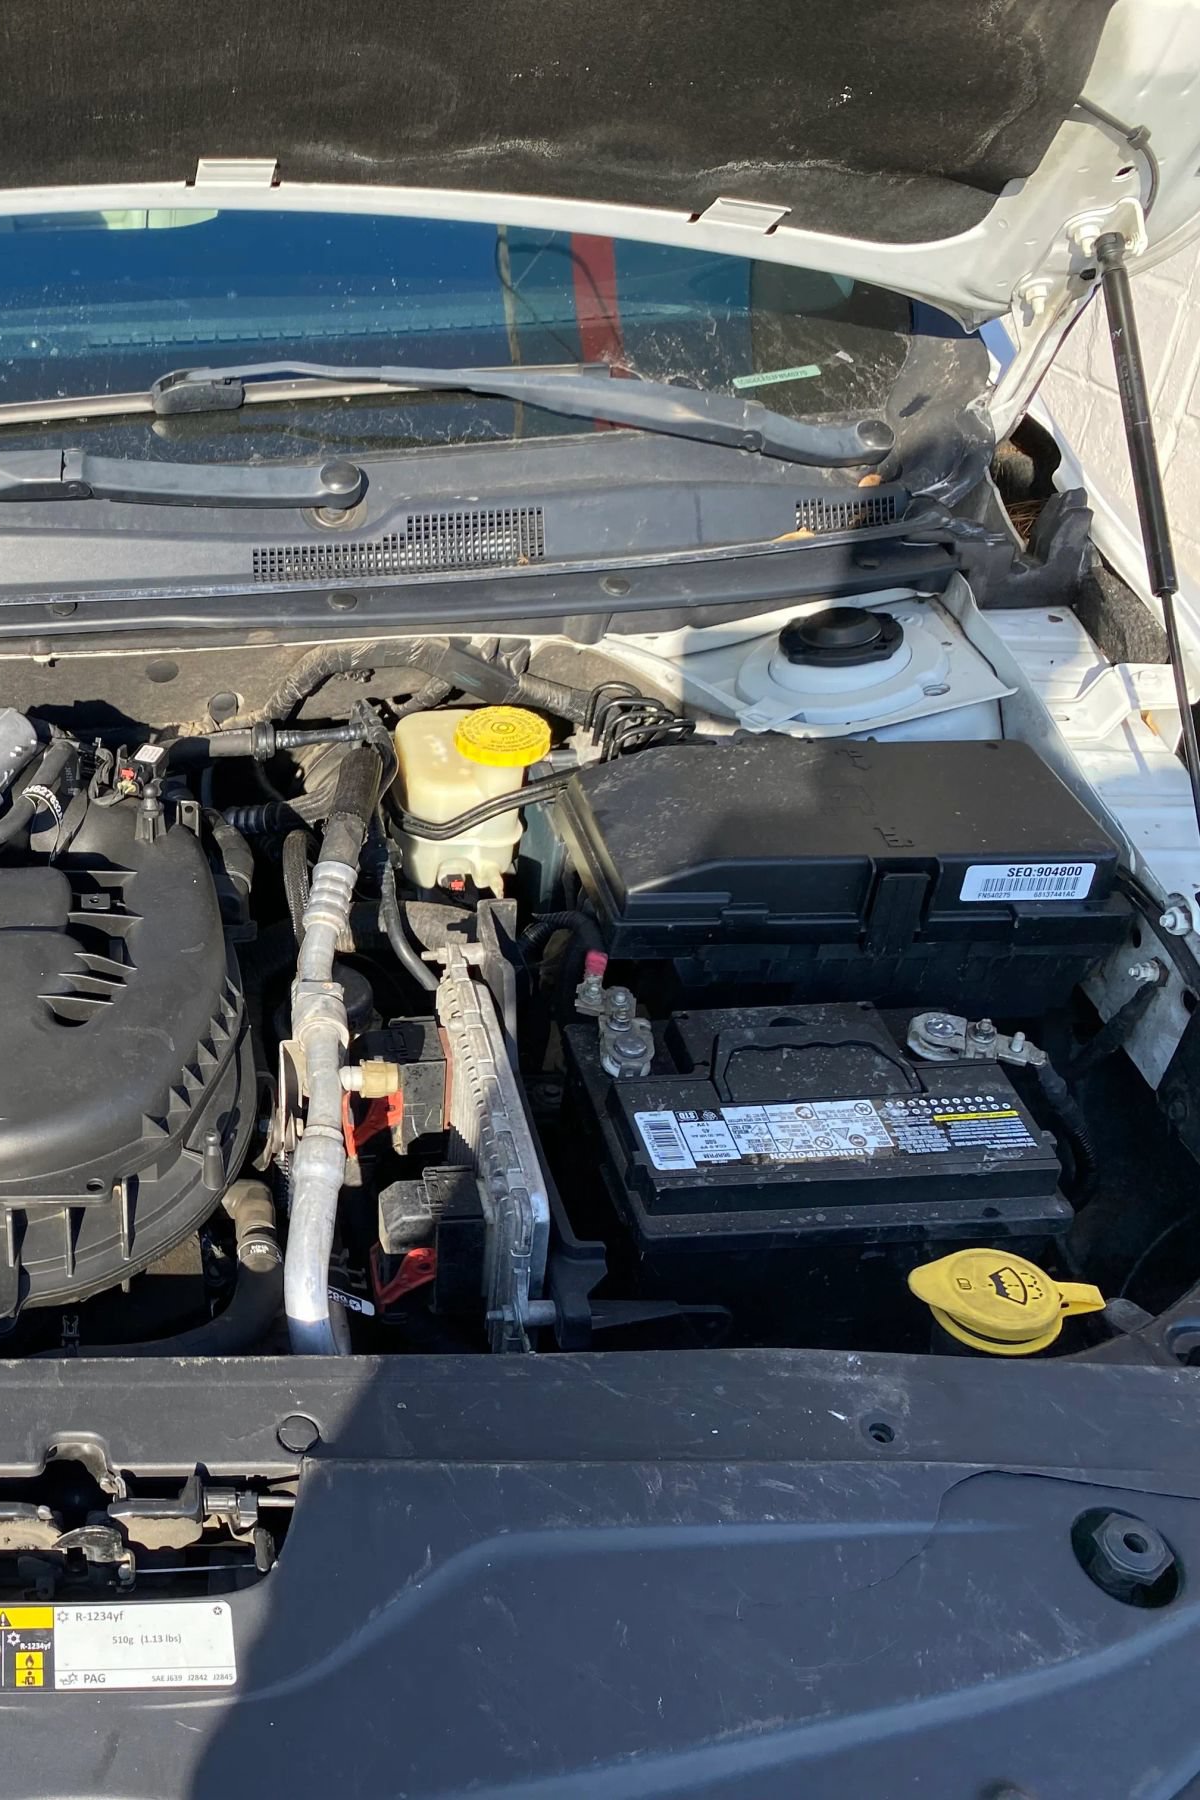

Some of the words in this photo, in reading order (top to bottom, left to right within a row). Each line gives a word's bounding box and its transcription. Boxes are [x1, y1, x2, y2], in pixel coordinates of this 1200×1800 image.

[1007, 866, 1082, 877] SEQ:904800
[770, 1147, 864, 1160] DANGER/POISON
[75, 1610, 124, 1623] R-1234yf
[112, 1635, 134, 1646] 510g
[140, 1634, 163, 1644] (1.13
[164, 1633, 182, 1644] lbs)
[20, 1641, 52, 1651] R-1234yf
[84, 1674, 106, 1684] PAG
